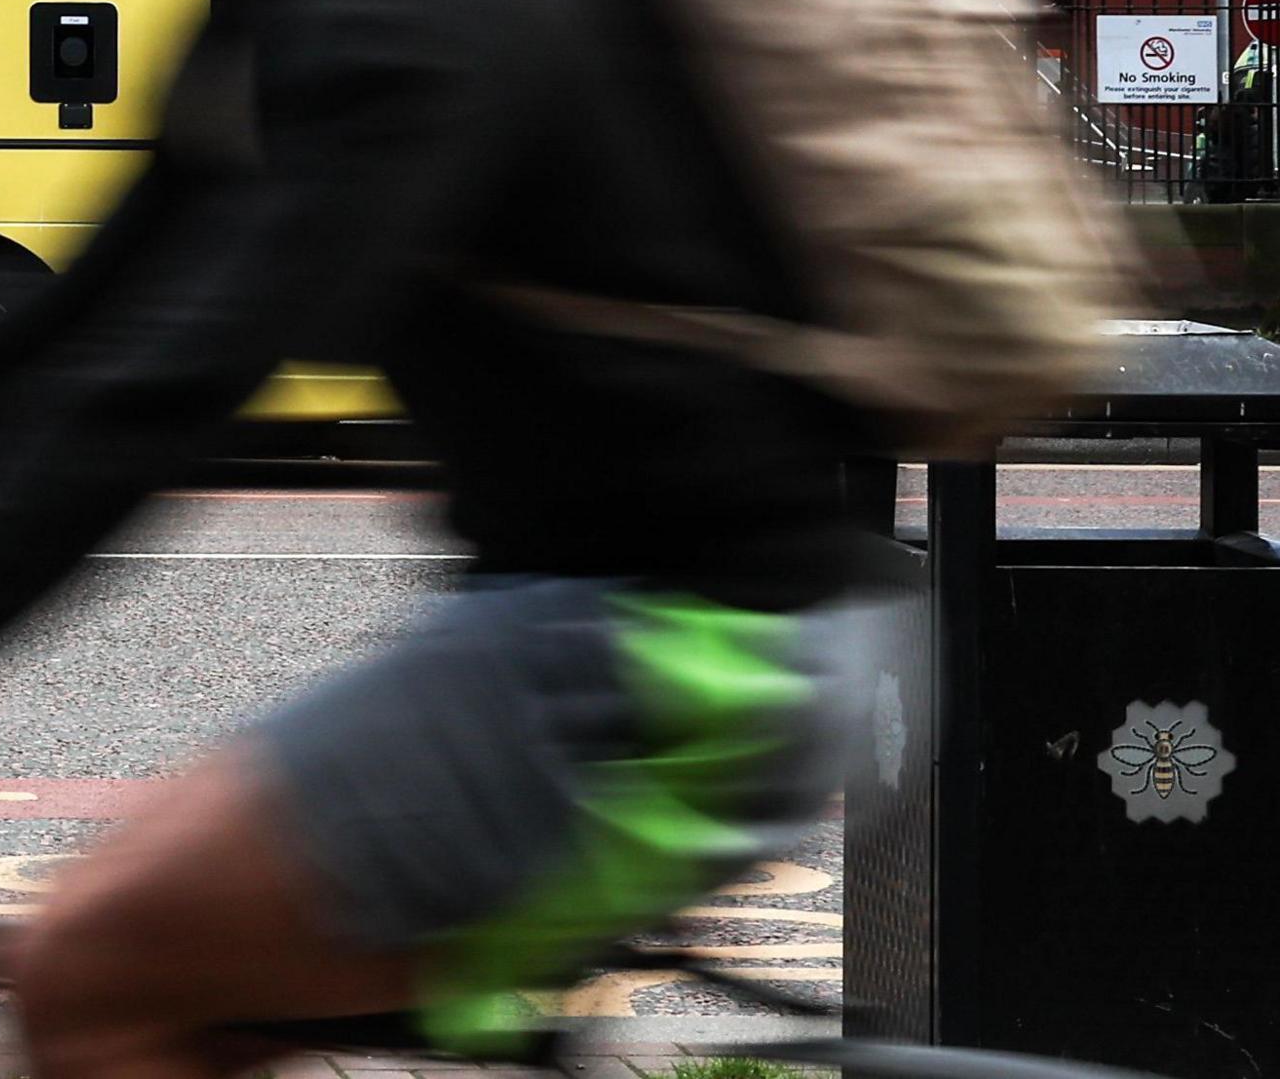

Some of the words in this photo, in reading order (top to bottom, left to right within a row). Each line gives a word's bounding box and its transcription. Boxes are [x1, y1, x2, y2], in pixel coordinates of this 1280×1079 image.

[1119, 72, 1137, 83] No
[1141, 72, 1196, 86] Smoking
[1148, 93, 1176, 101] entering
